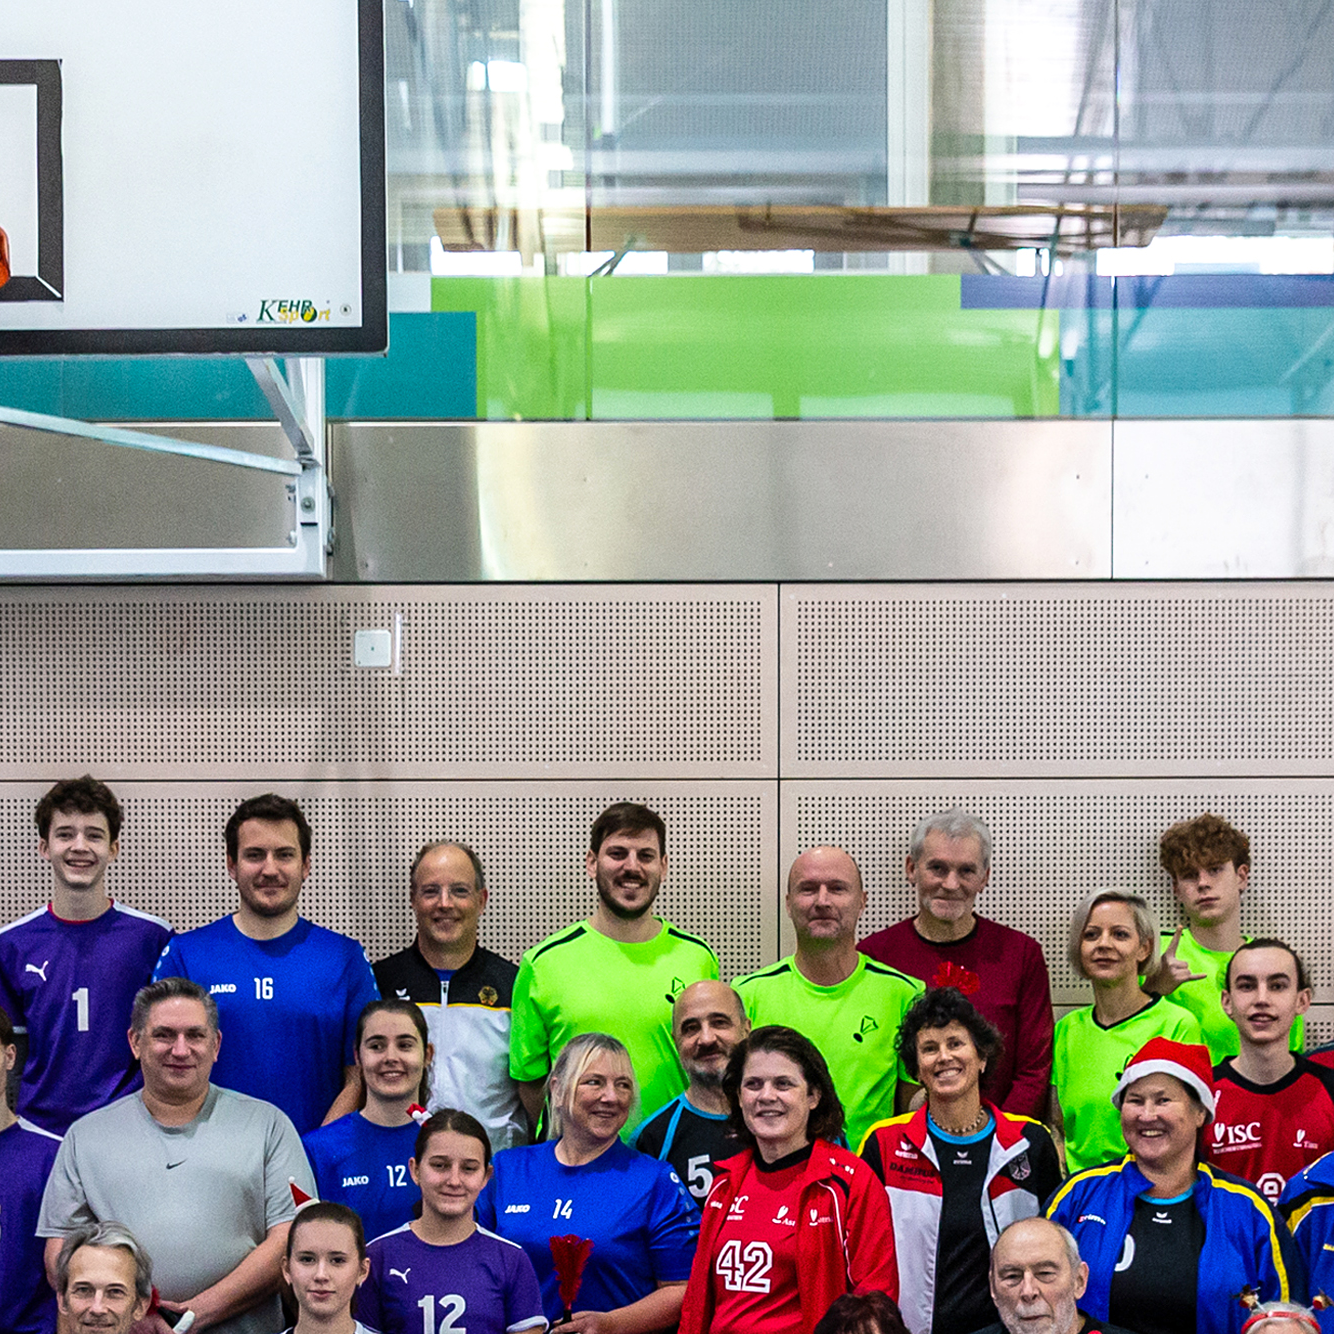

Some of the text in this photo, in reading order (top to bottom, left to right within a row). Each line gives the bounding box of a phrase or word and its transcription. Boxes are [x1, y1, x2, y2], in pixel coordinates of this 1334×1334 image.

[209, 983, 237, 995] JAKO
[254, 977, 274, 1000] 16
[71, 987, 90, 1032] 1
[1227, 1121, 1262, 1145] ISC
[342, 1175, 369, 1188] JAKO
[385, 1164, 408, 1188] 12
[687, 1153, 714, 1198] 5
[552, 1198, 573, 1220] 14
[715, 1239, 773, 1294] 42
